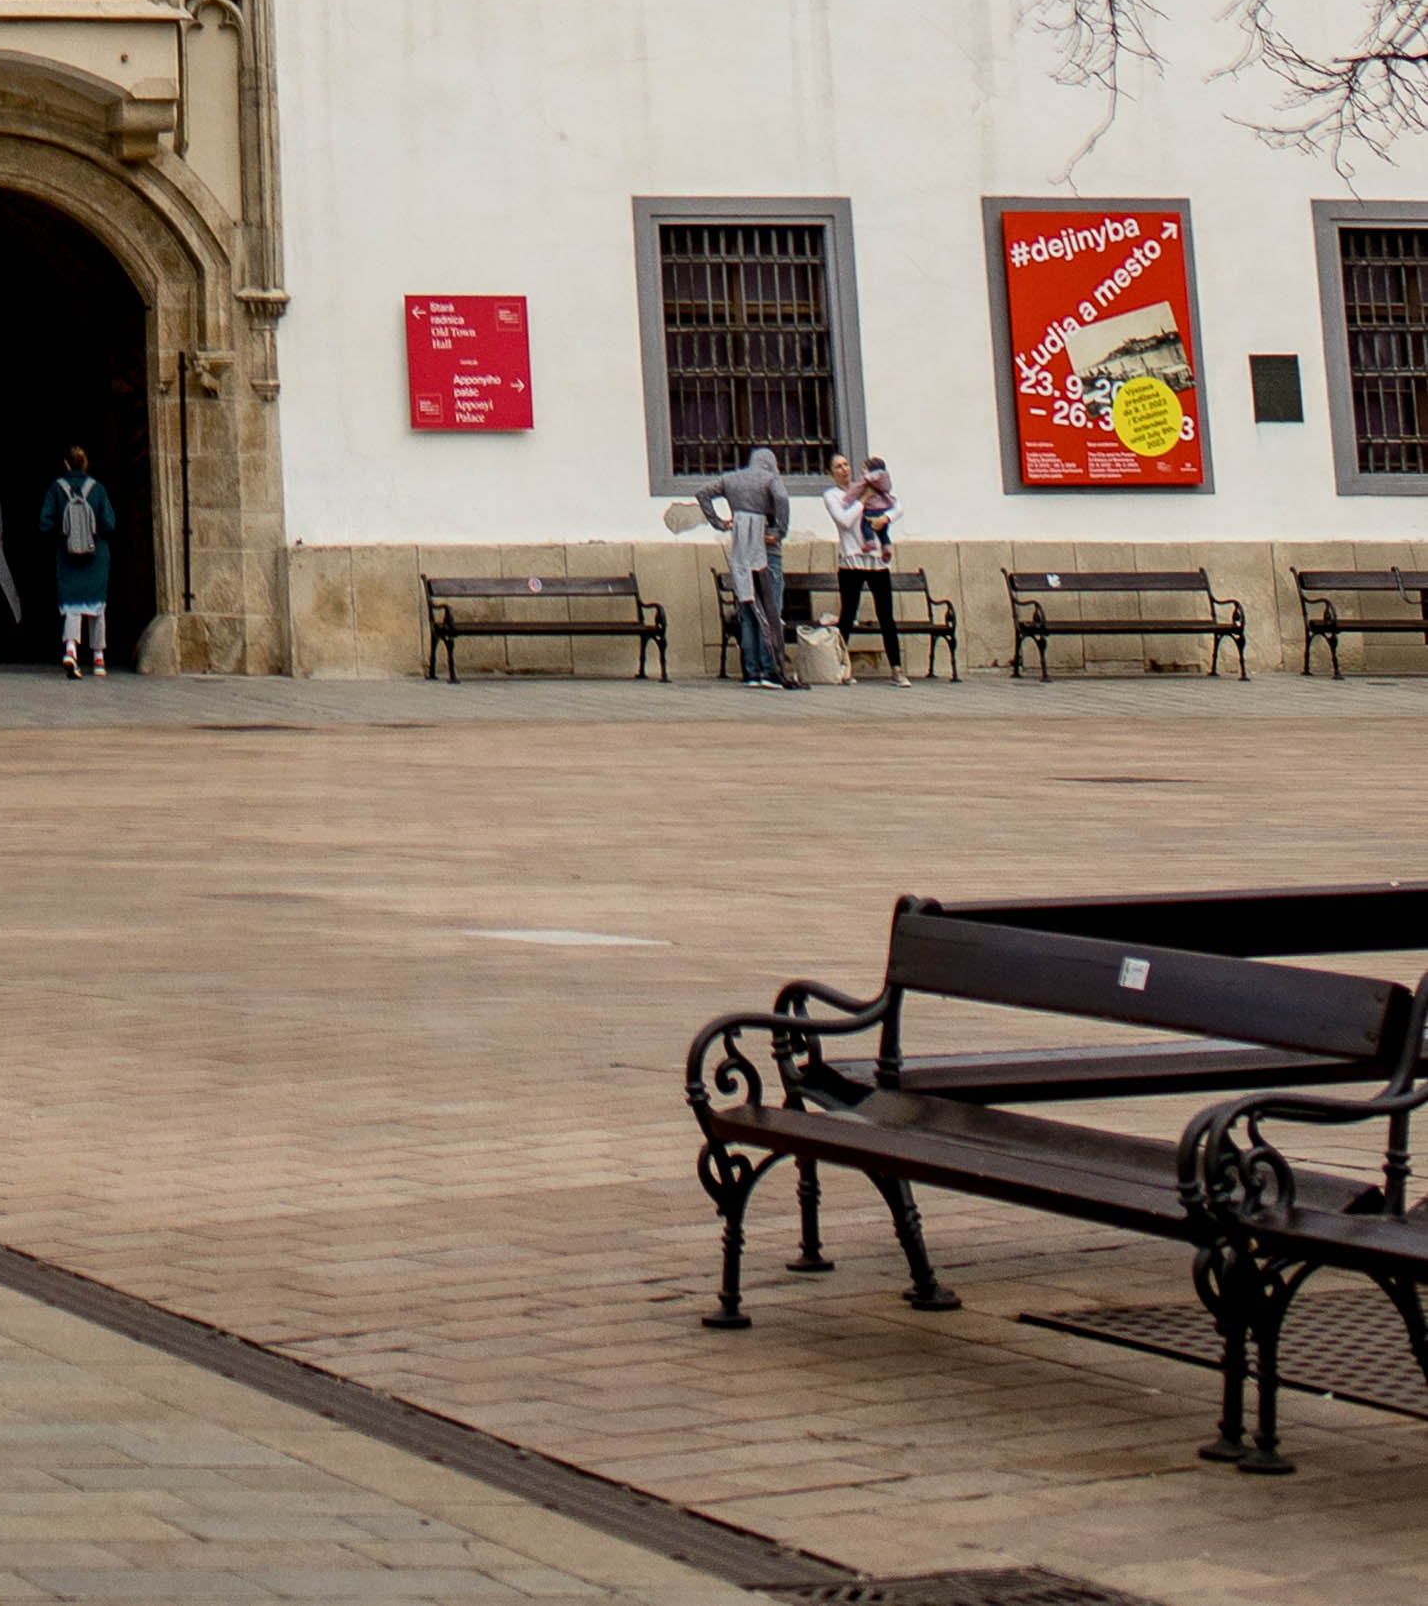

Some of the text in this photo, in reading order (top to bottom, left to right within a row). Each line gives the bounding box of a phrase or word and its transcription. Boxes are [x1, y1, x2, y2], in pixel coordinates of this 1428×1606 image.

[1009, 218, 1140, 268] #dejinyba
[1078, 301, 1098, 322] a
[1093, 240, 1161, 307] mesto
[1053, 400, 1094, 429] 26.
